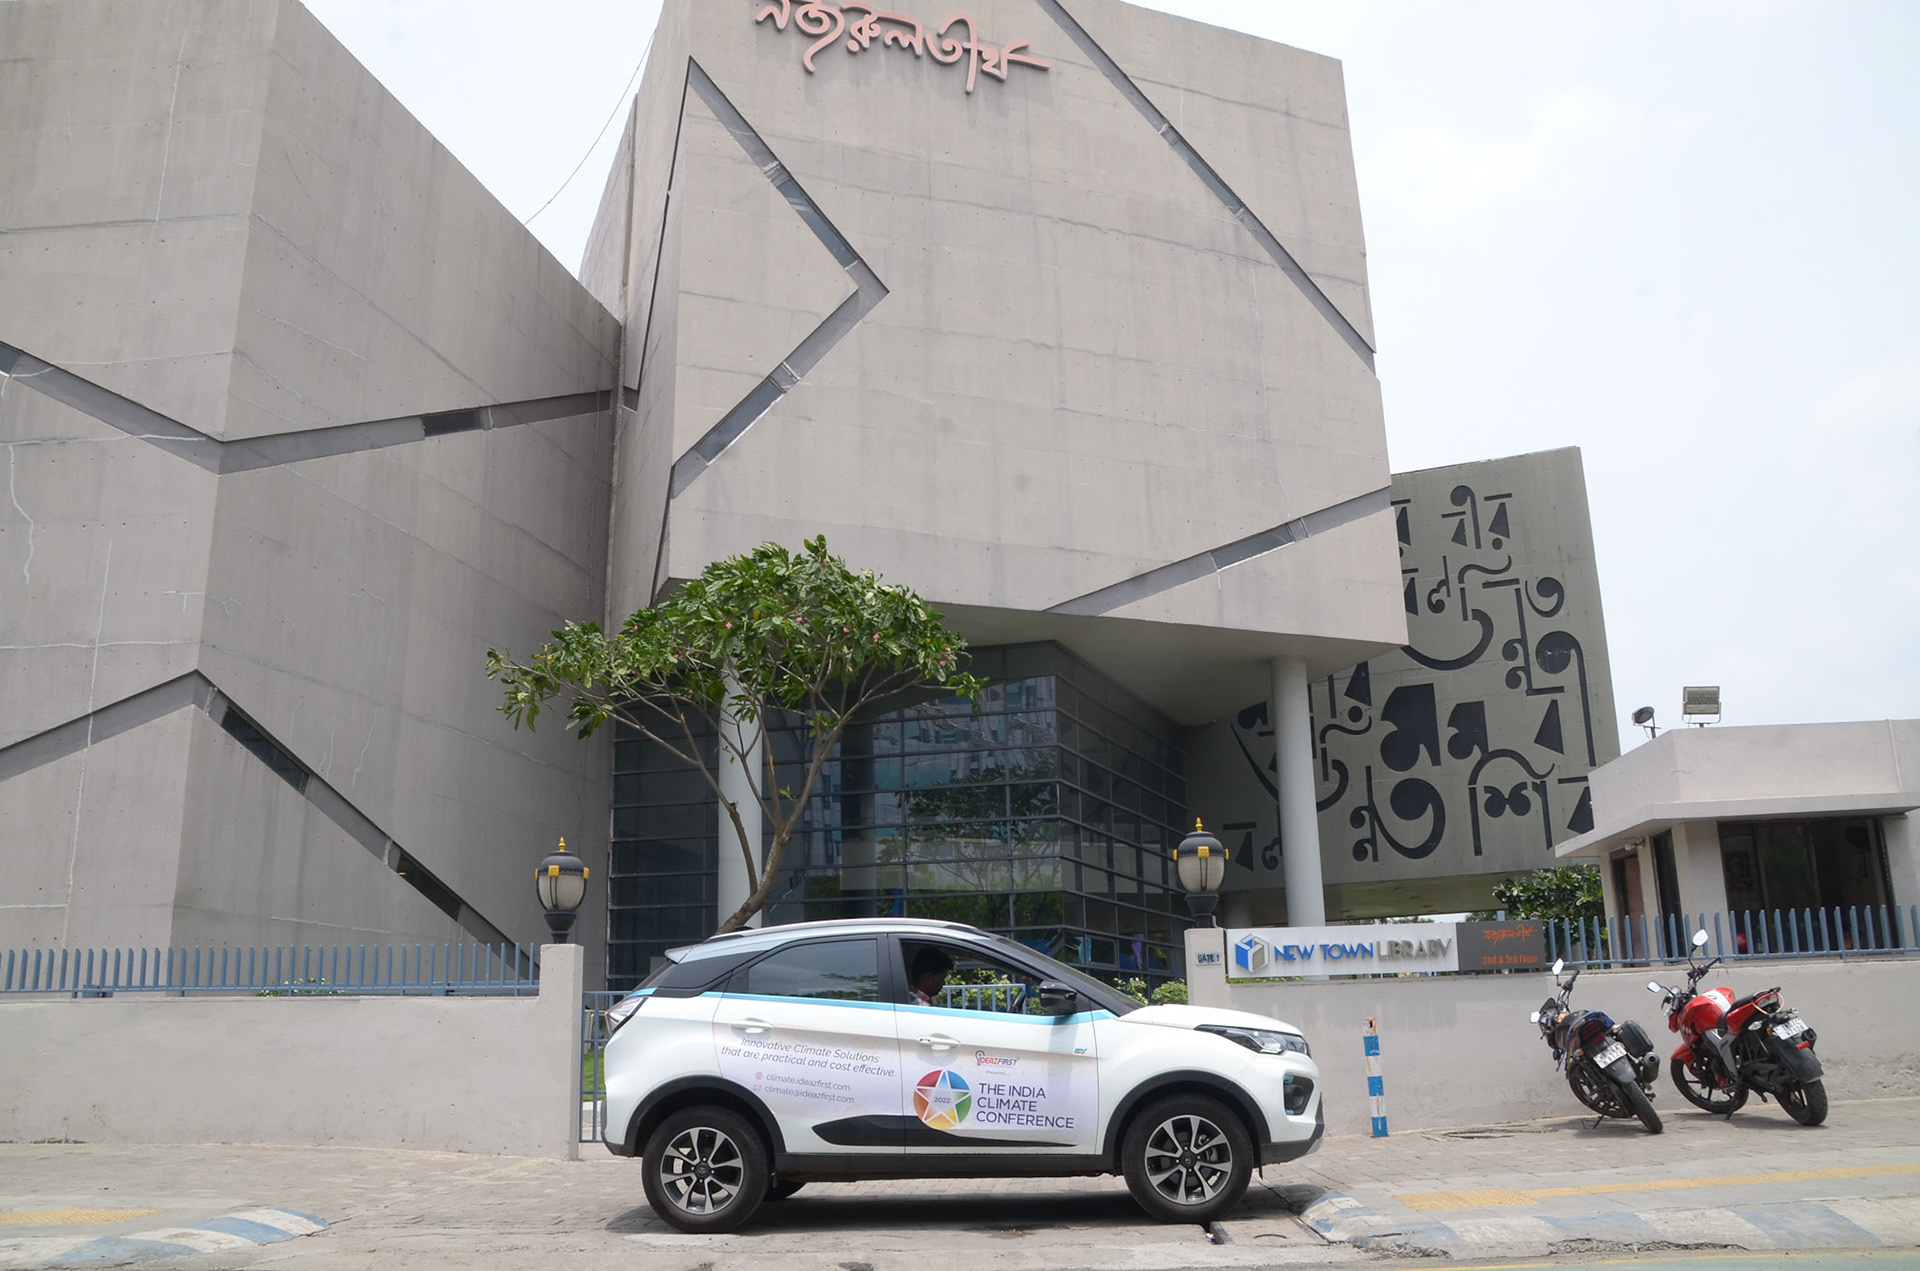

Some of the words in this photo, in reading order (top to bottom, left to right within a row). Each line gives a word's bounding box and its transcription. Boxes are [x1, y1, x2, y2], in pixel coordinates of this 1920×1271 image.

[1197, 954, 1214, 964] GATE
[1274, 944, 1315, 962] NEW
[1320, 942, 1374, 961] TOWN
[1376, 938, 1452, 962] LIBRARY
[1520, 954, 1538, 964] Floor
[740, 1037, 792, 1053] Innovative
[793, 1043, 831, 1058] Climate
[833, 1049, 880, 1064] Solutions
[721, 1046, 742, 1057] that
[743, 1051, 760, 1060] are
[761, 1052, 806, 1066] practical
[808, 1057, 828, 1068] and
[829, 1060, 851, 1072] cost
[853, 1063, 896, 1078] effective.
[766, 1072, 851, 1092] climate.ideazfirst.com
[979, 1082, 1006, 1096] THE
[1009, 1085, 1047, 1099] INDIA
[764, 1085, 855, 1104] climate@ideazfirst.com
[934, 1096, 950, 1104] 2022
[977, 1096, 1037, 1112] CLIMATE
[976, 1110, 1075, 1129] CONFERENCE
